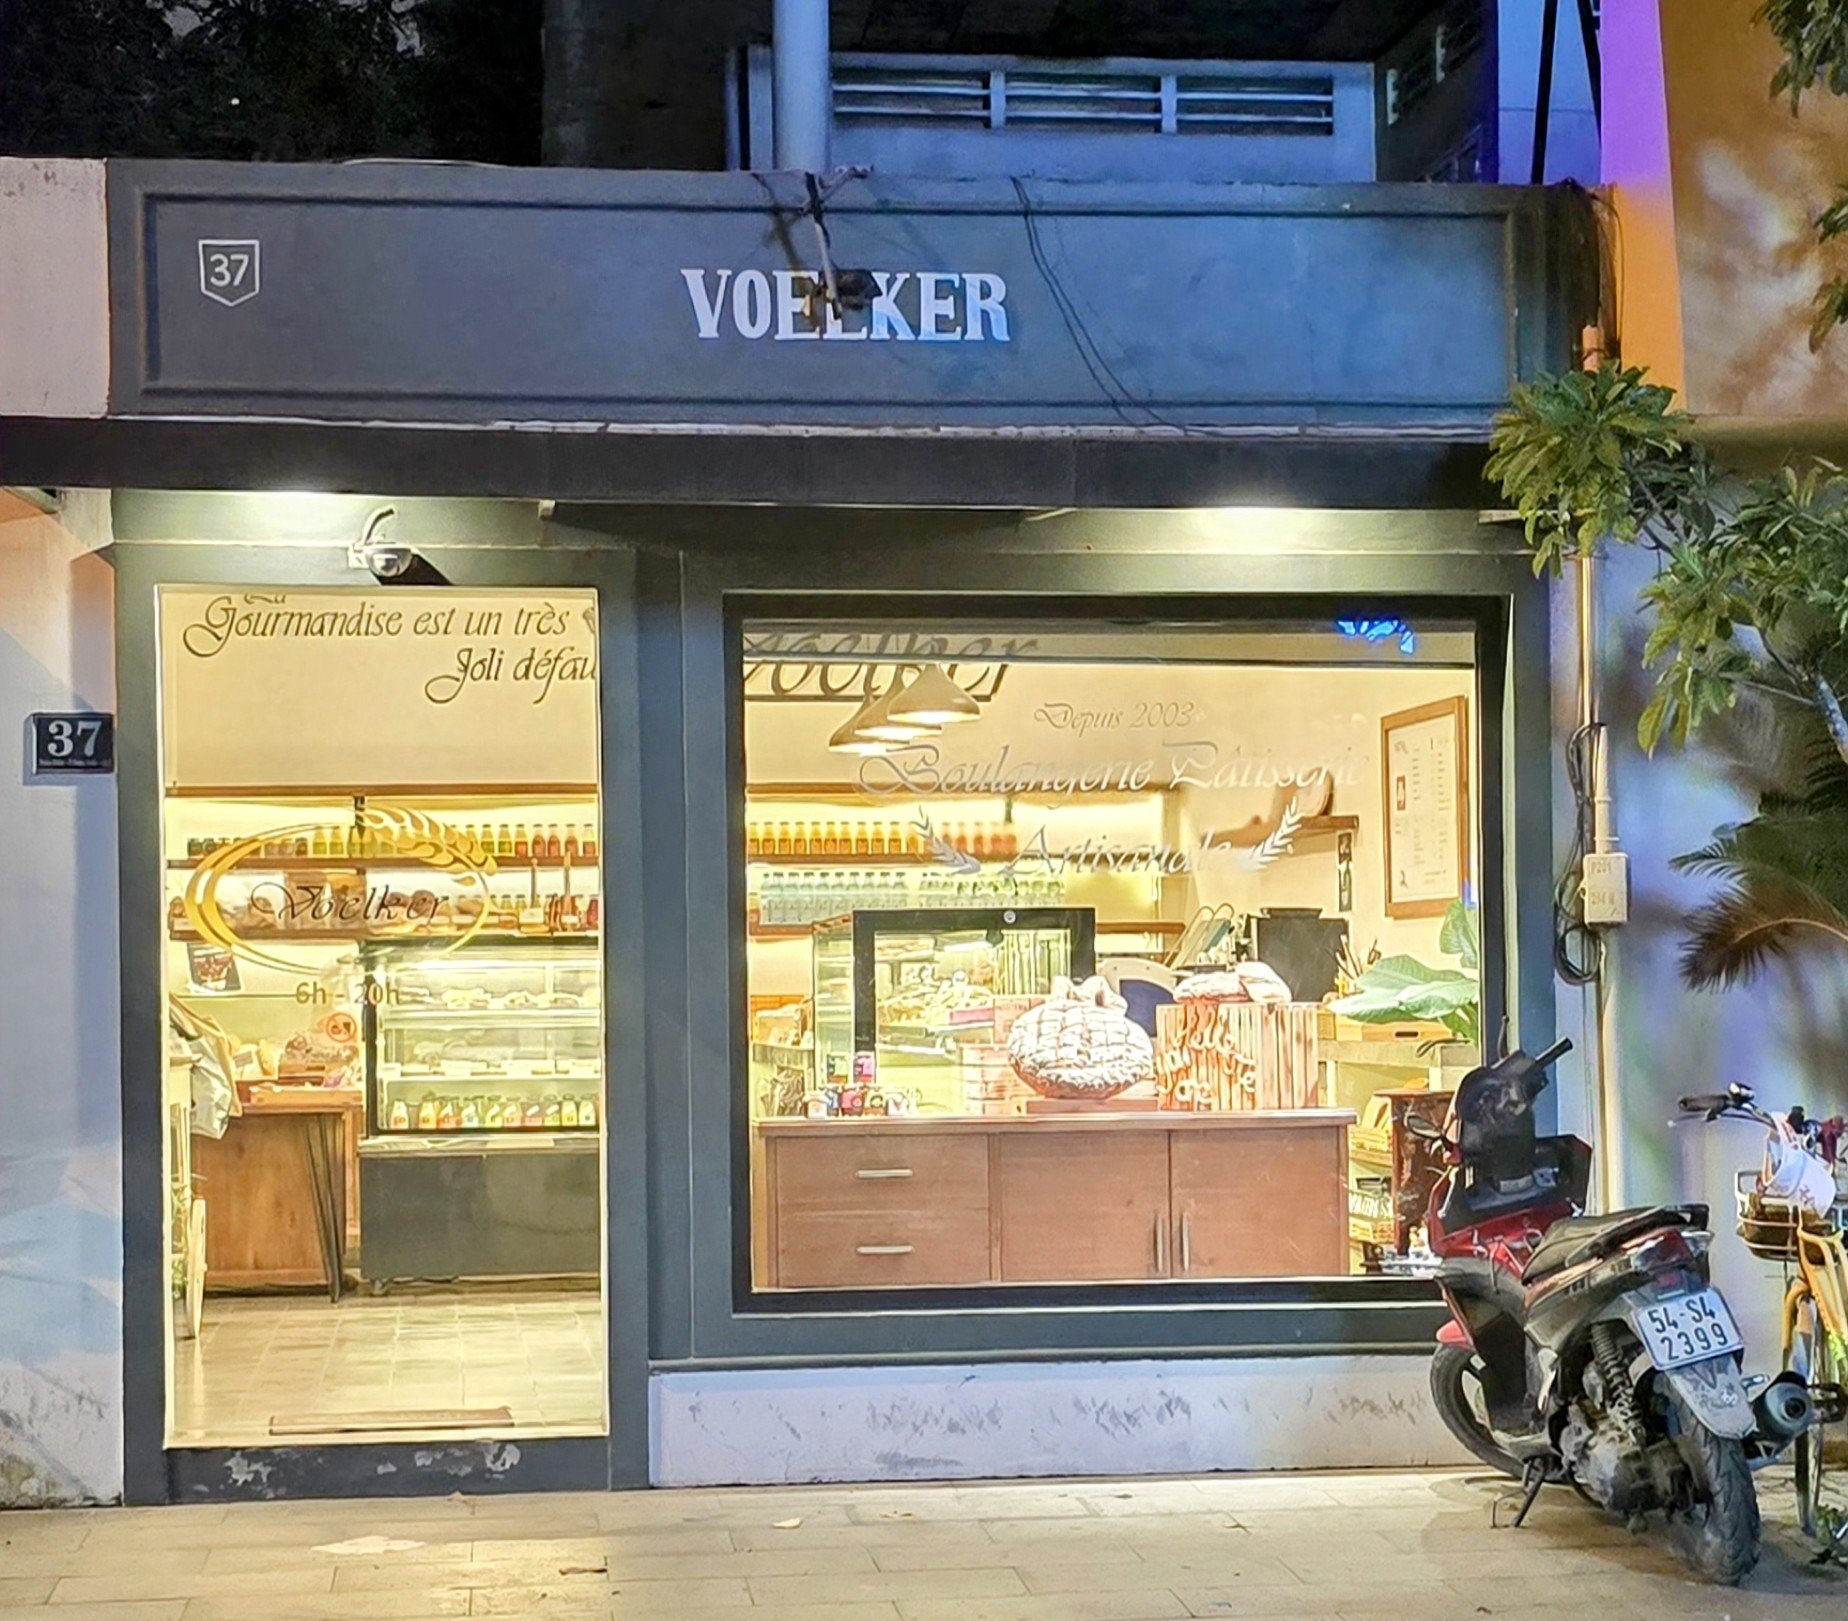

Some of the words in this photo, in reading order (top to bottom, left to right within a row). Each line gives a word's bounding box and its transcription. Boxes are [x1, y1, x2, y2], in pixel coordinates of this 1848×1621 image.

[210, 253, 249, 287] 37
[183, 596, 402, 658] Gourmandise
[413, 608, 456, 637] est
[464, 610, 502, 637] un
[514, 602, 570, 635] très
[1034, 703, 1123, 737] Depuis
[1129, 702, 1194, 728] 2003
[47, 720, 102, 757] 37
[858, 744, 1154, 806] Boulangerie
[250, 881, 450, 921] Voelker
[295, 981, 327, 1004] 6h
[353, 981, 400, 1004] 20h
[1647, 1296, 1716, 1333] 54-S4
[1660, 1323, 1729, 1361] 2399
